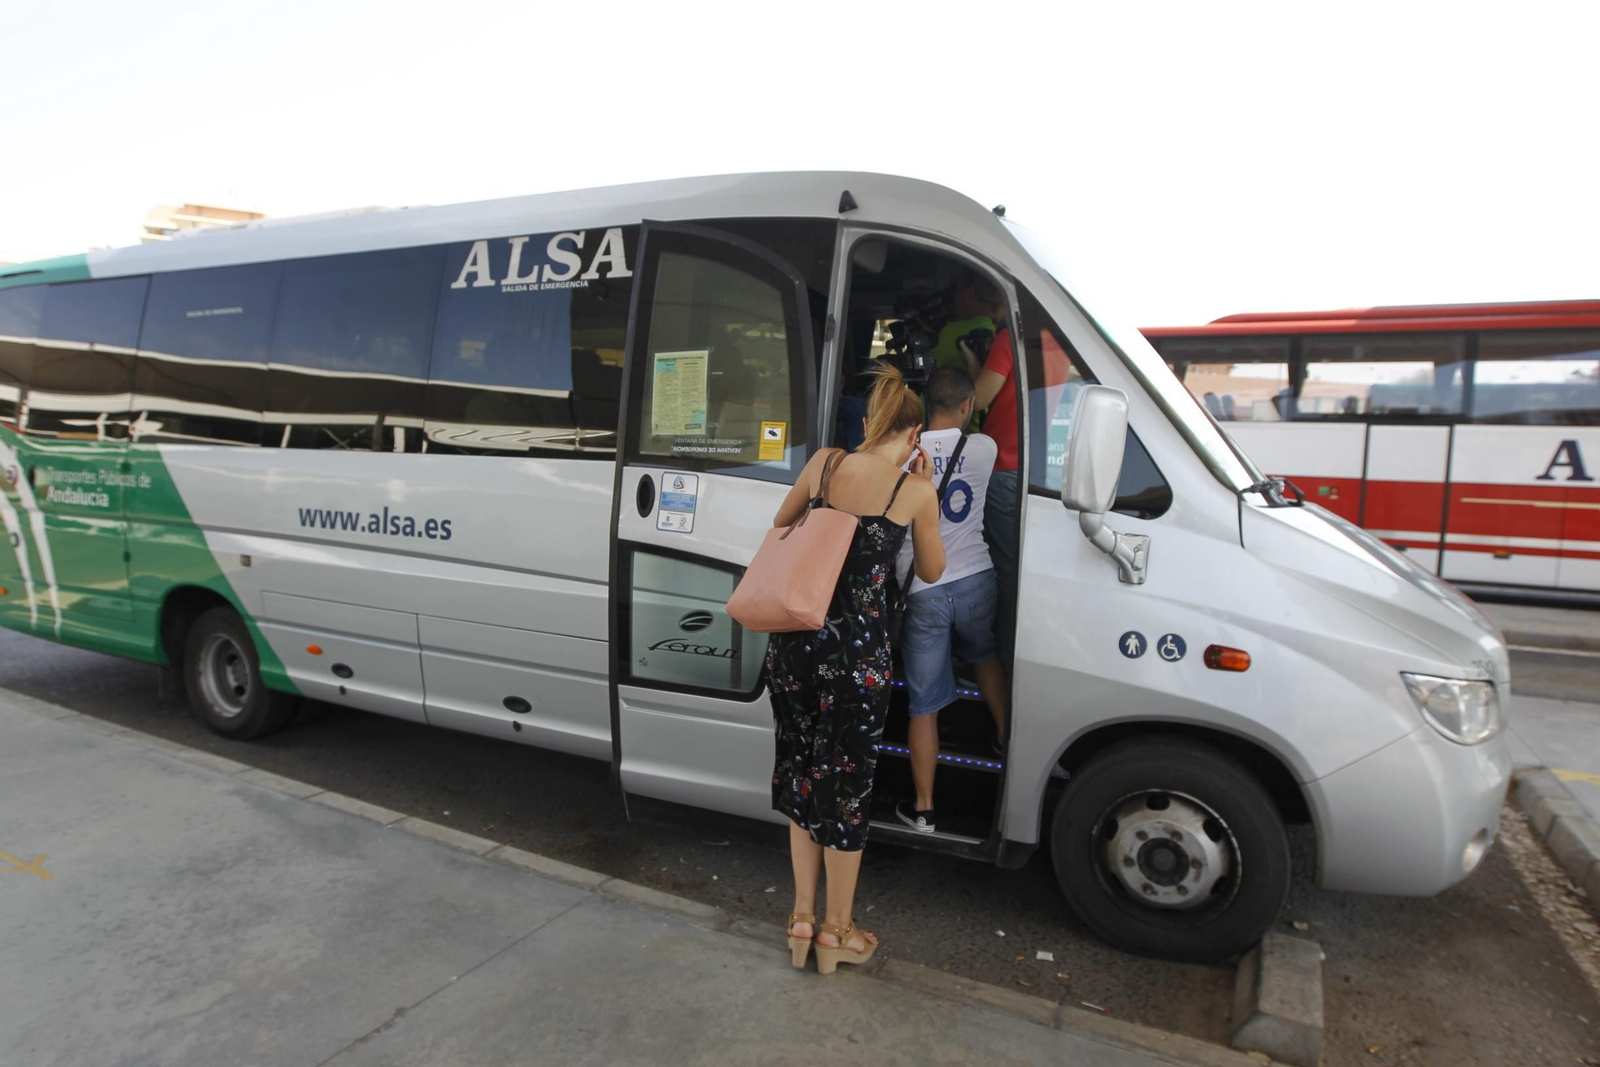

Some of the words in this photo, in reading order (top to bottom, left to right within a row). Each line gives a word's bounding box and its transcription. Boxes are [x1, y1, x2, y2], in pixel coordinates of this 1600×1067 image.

[450, 227, 633, 289] ALSA
[501, 284, 528, 294] SALIDA
[528, 283, 539, 291] DE
[540, 280, 589, 290] EMERGENCIA
[298, 506, 453, 541] www.alsa.es
